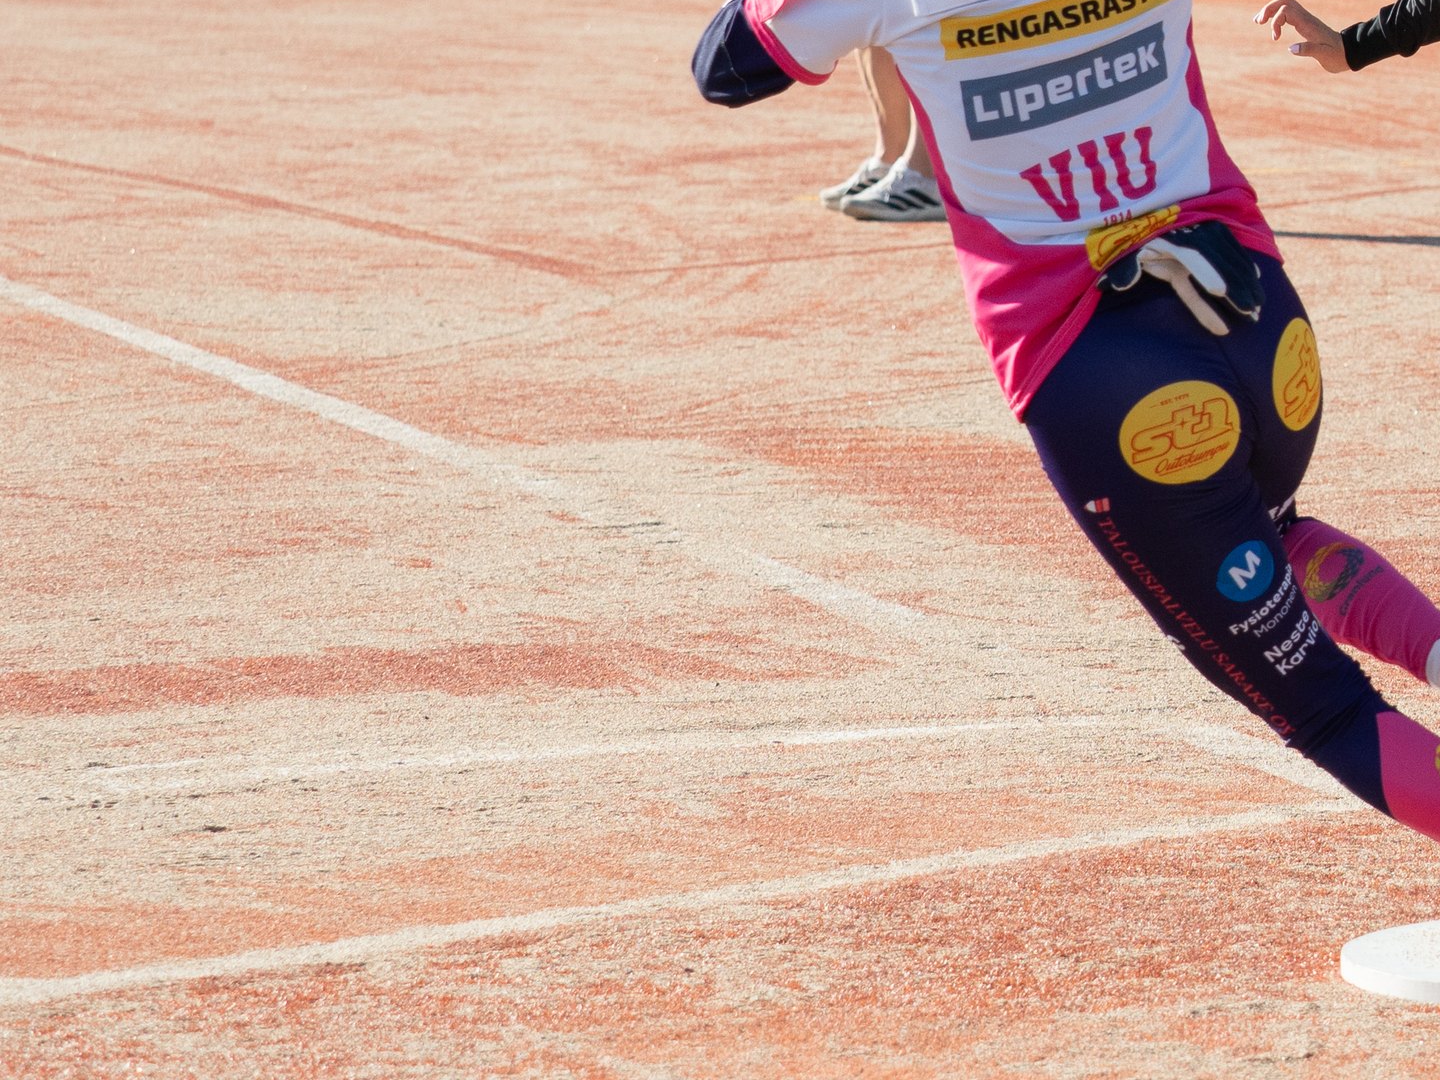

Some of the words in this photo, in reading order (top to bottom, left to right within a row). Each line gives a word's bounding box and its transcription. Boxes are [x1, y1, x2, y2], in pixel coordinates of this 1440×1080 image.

[1019, 126, 1157, 222] VIU
[1103, 209, 1133, 227] 1914
[1228, 550, 1261, 590] M
[1099, 517, 1219, 652] TALOUSPALVELU
[1212, 649, 1275, 712] SARAKE
[1253, 584, 1298, 638] Mononen
[1263, 610, 1310, 663] Neste
